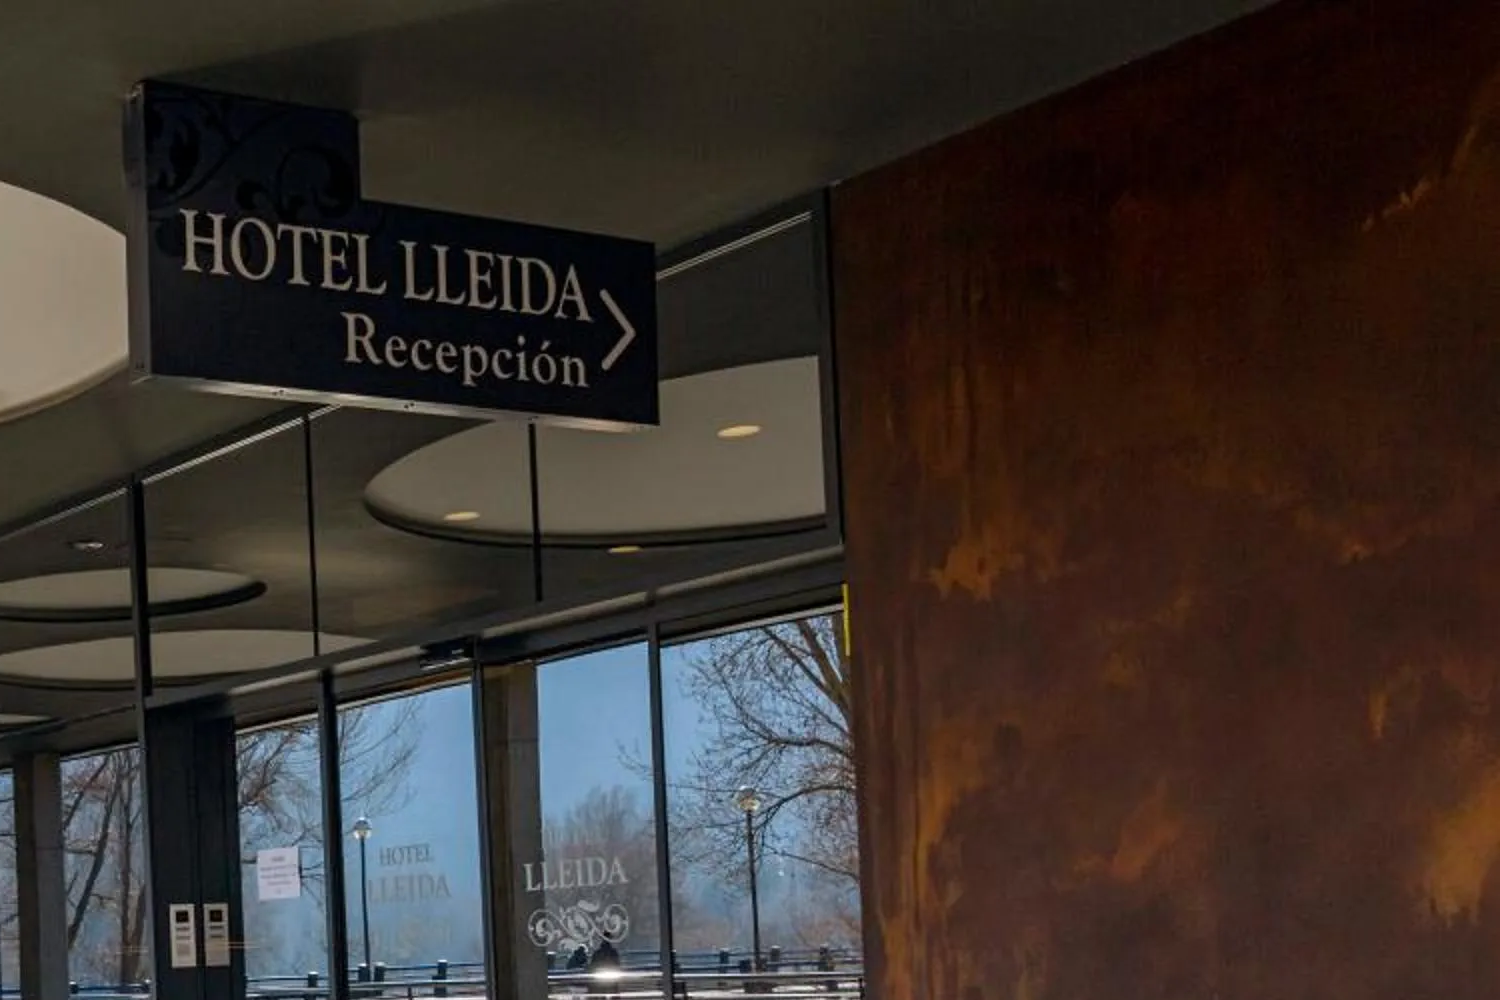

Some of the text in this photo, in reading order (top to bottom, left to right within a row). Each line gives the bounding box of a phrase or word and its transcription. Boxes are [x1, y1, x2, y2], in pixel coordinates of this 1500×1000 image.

[179, 208, 595, 323] HOTEL LLEIDA
[340, 311, 590, 388] Recepción
[379, 843, 435, 866] HOTEL
[366, 873, 452, 903] LLEIDA
[523, 856, 629, 892] LLEIDA
